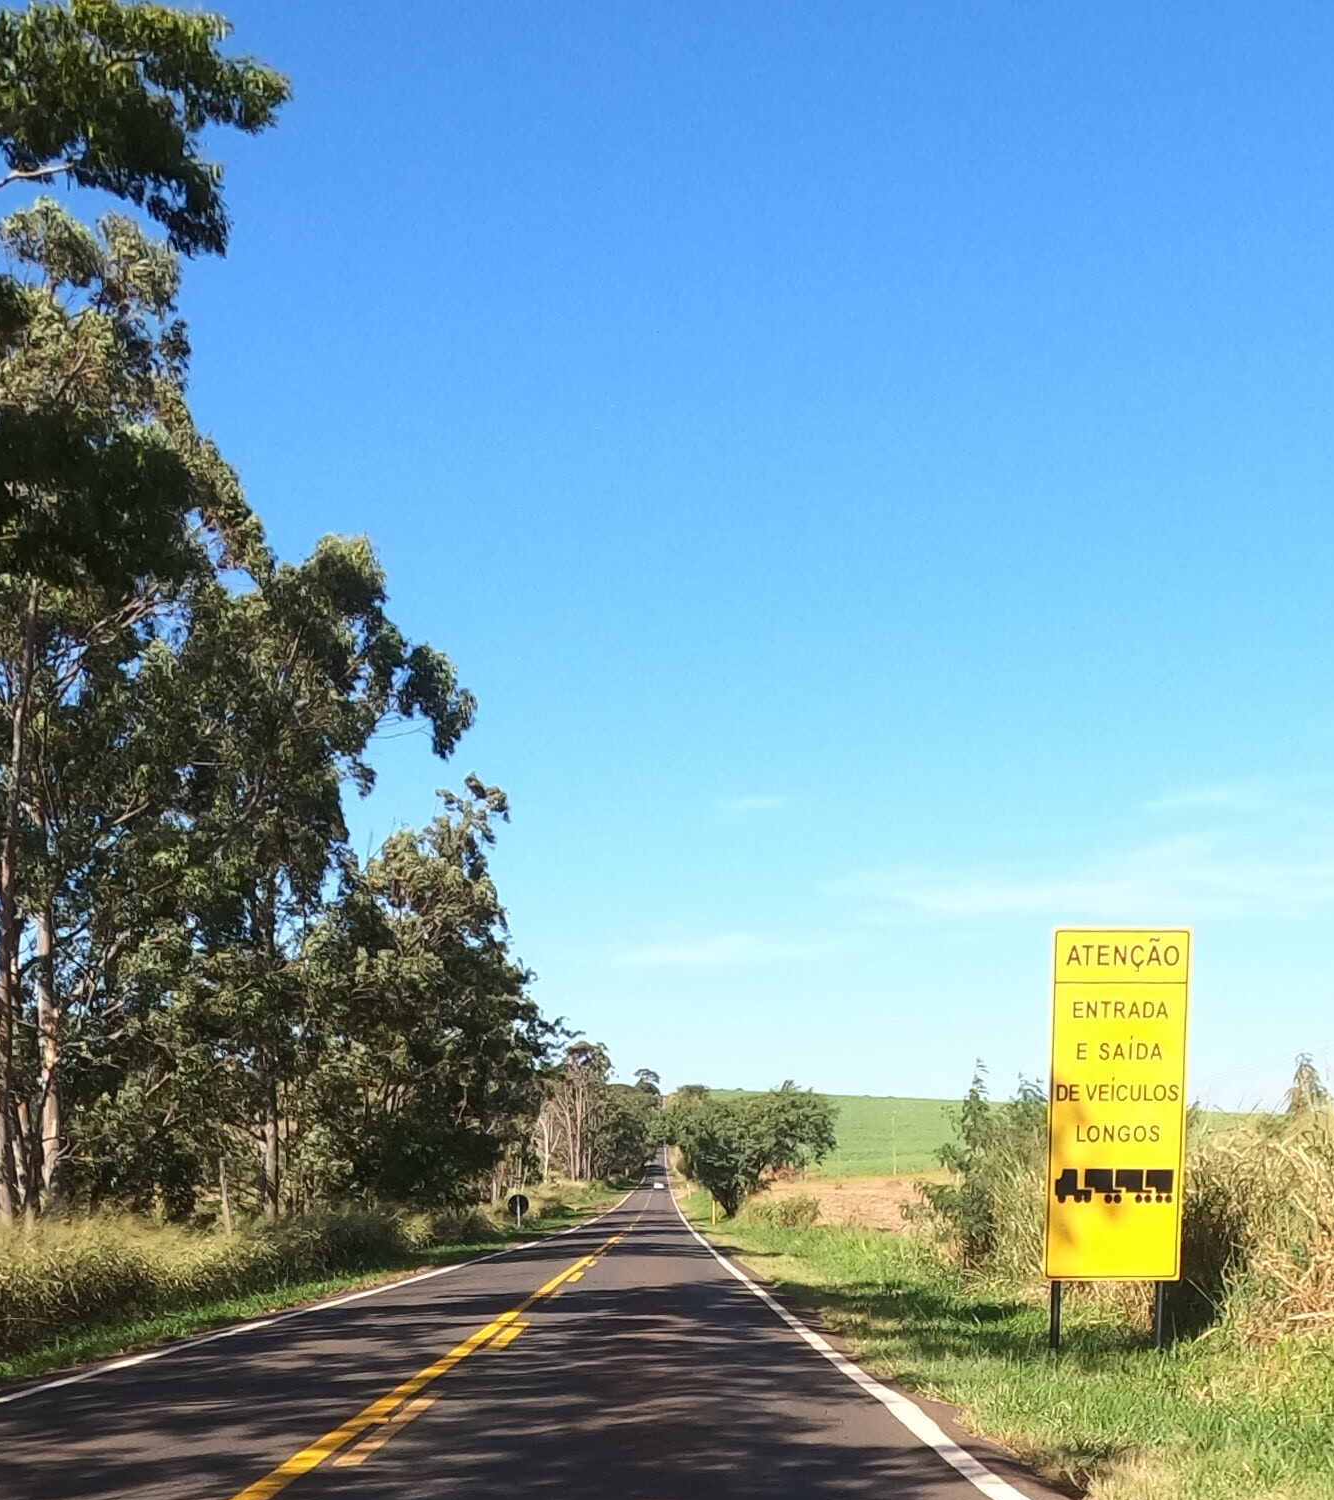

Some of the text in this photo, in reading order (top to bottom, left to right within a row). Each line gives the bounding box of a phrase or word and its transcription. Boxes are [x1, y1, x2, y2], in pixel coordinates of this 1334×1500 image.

[1066, 937, 1180, 972] ATENÇÃO
[1072, 1001, 1169, 1019] ENTRADA
[1076, 1035, 1162, 1060] E SAÍDA
[1056, 1076, 1179, 1102] DE VEÍCULOS
[1076, 1125, 1160, 1143] LONGOS
